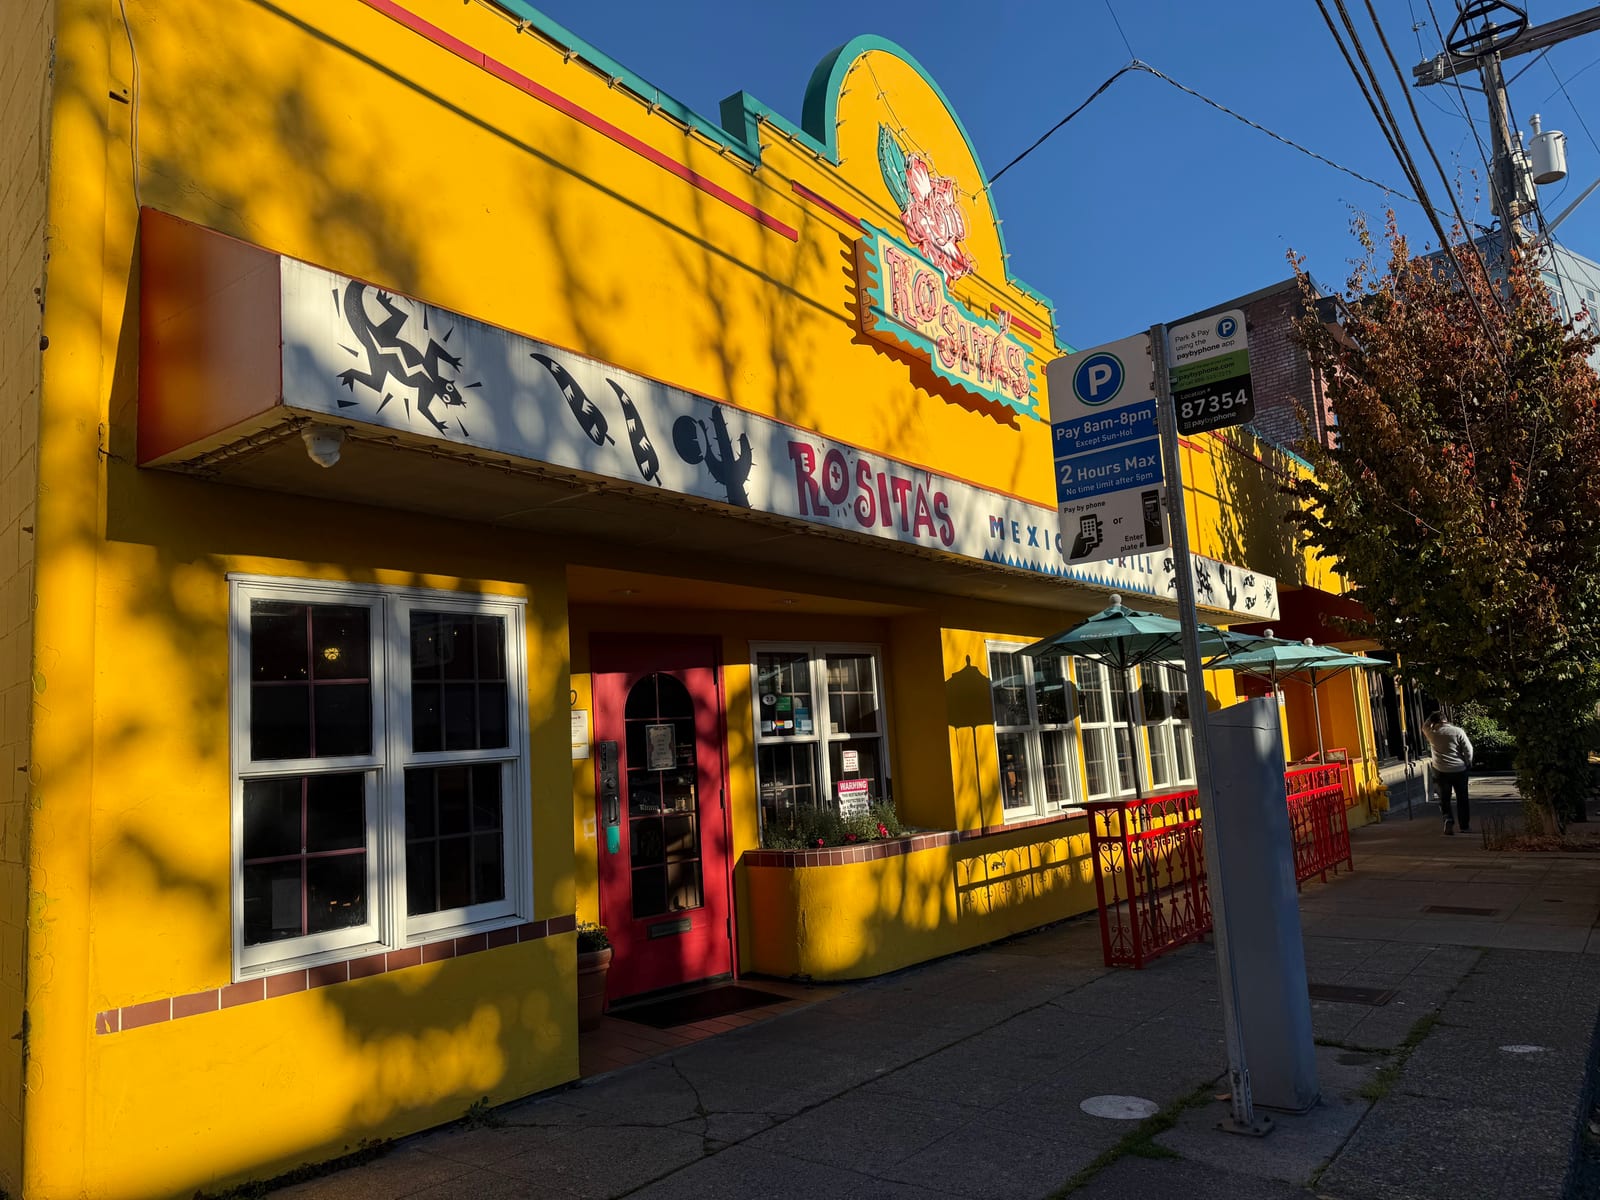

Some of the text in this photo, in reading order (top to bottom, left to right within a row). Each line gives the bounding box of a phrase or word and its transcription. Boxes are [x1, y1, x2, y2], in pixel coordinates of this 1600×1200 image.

[1175, 329, 1210, 342] Park & Pay
[1222, 321, 1233, 335] P
[1175, 338, 1206, 352] using the
[1176, 339, 1235, 360] paybyphone app
[1087, 363, 1112, 397] P
[1180, 389, 1206, 400] Location
[1181, 388, 1248, 419] 87354
[1056, 409, 1151, 440] Pay 8am-8pm
[1192, 411, 1237, 428] paybyphone
[1075, 428, 1133, 448] Except Sun-Hol
[1060, 455, 1156, 484] 2 Hours Max
[1078, 485, 1095, 493] time
[1096, 480, 1113, 489] limit
[1115, 476, 1134, 485] after
[1135, 471, 1153, 482] 5pm
[1063, 501, 1106, 514] Pay by phone
[1112, 517, 1123, 525] or
[989, 514, 1063, 555] MEXIC
[1124, 534, 1144, 542] Enter
[1120, 542, 1138, 552] plate
